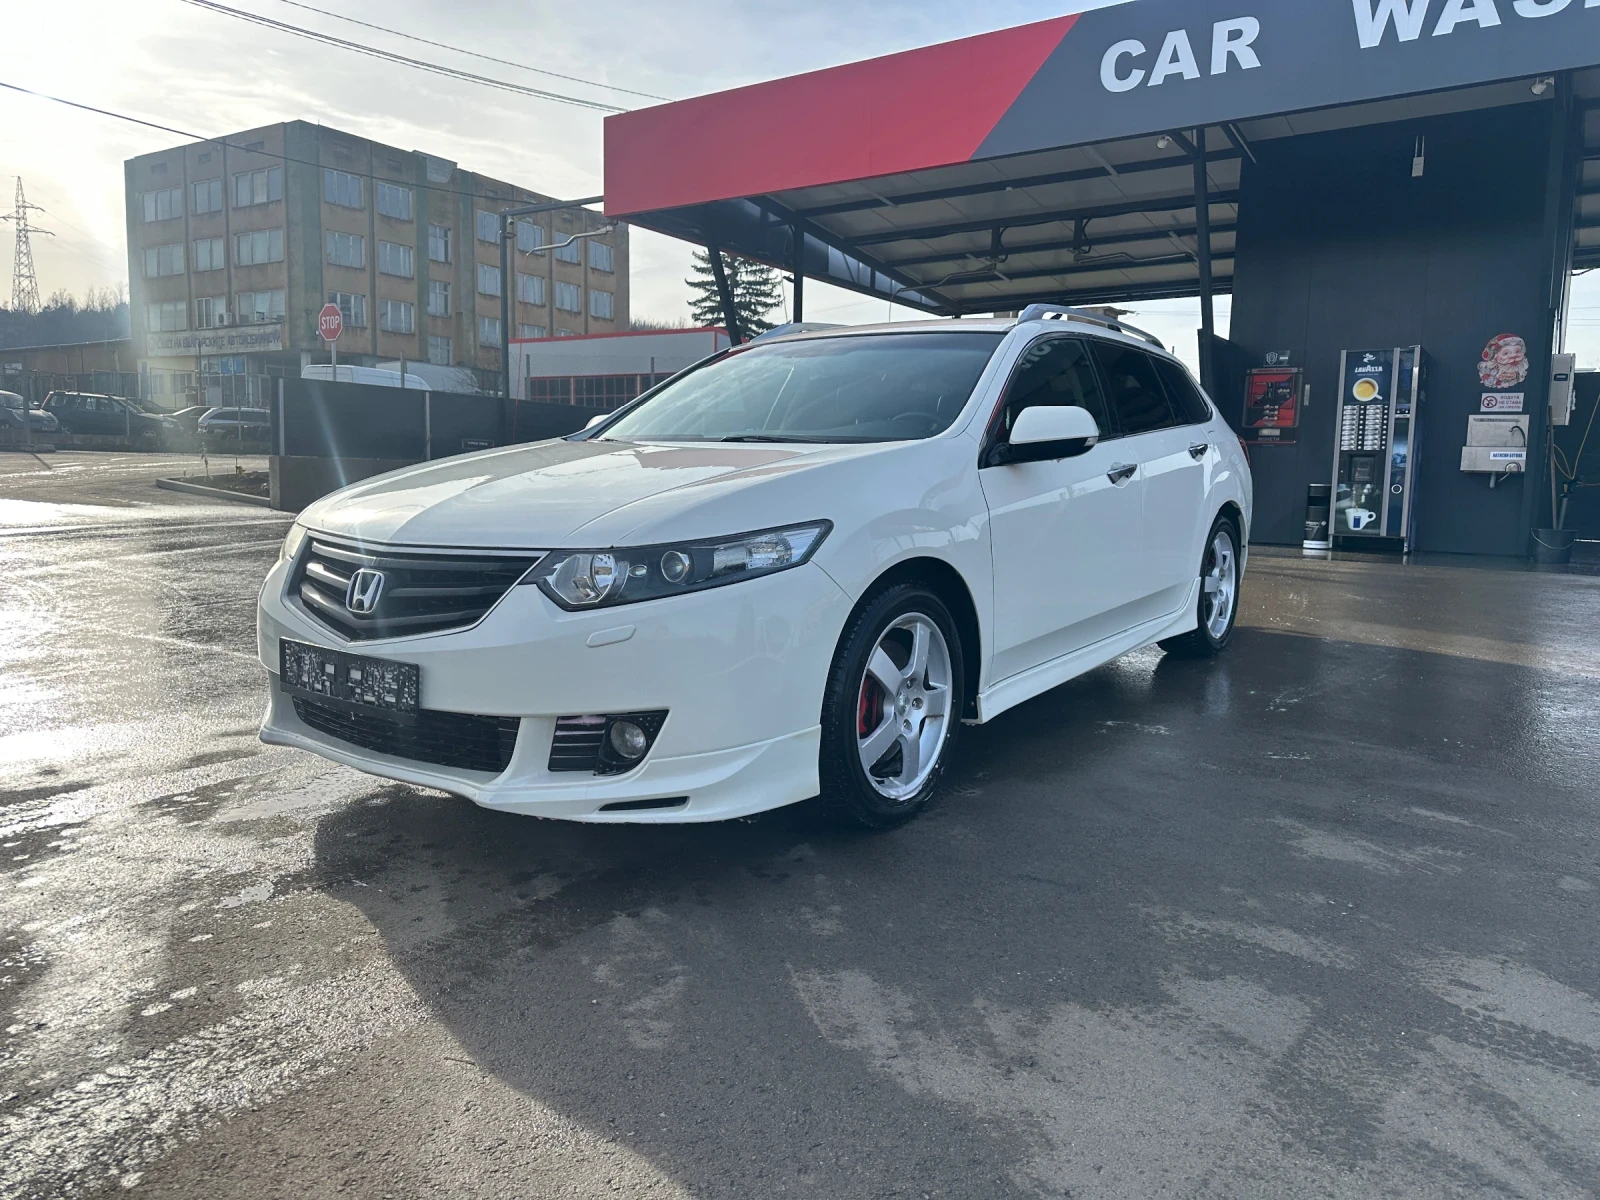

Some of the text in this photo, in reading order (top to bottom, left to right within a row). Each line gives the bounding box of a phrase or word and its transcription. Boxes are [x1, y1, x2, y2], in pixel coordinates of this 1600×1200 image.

[1100, 16, 1261, 93] CAR
[321, 316, 340, 330] STOP
[1354, 365, 1383, 373] LAVAZZA
